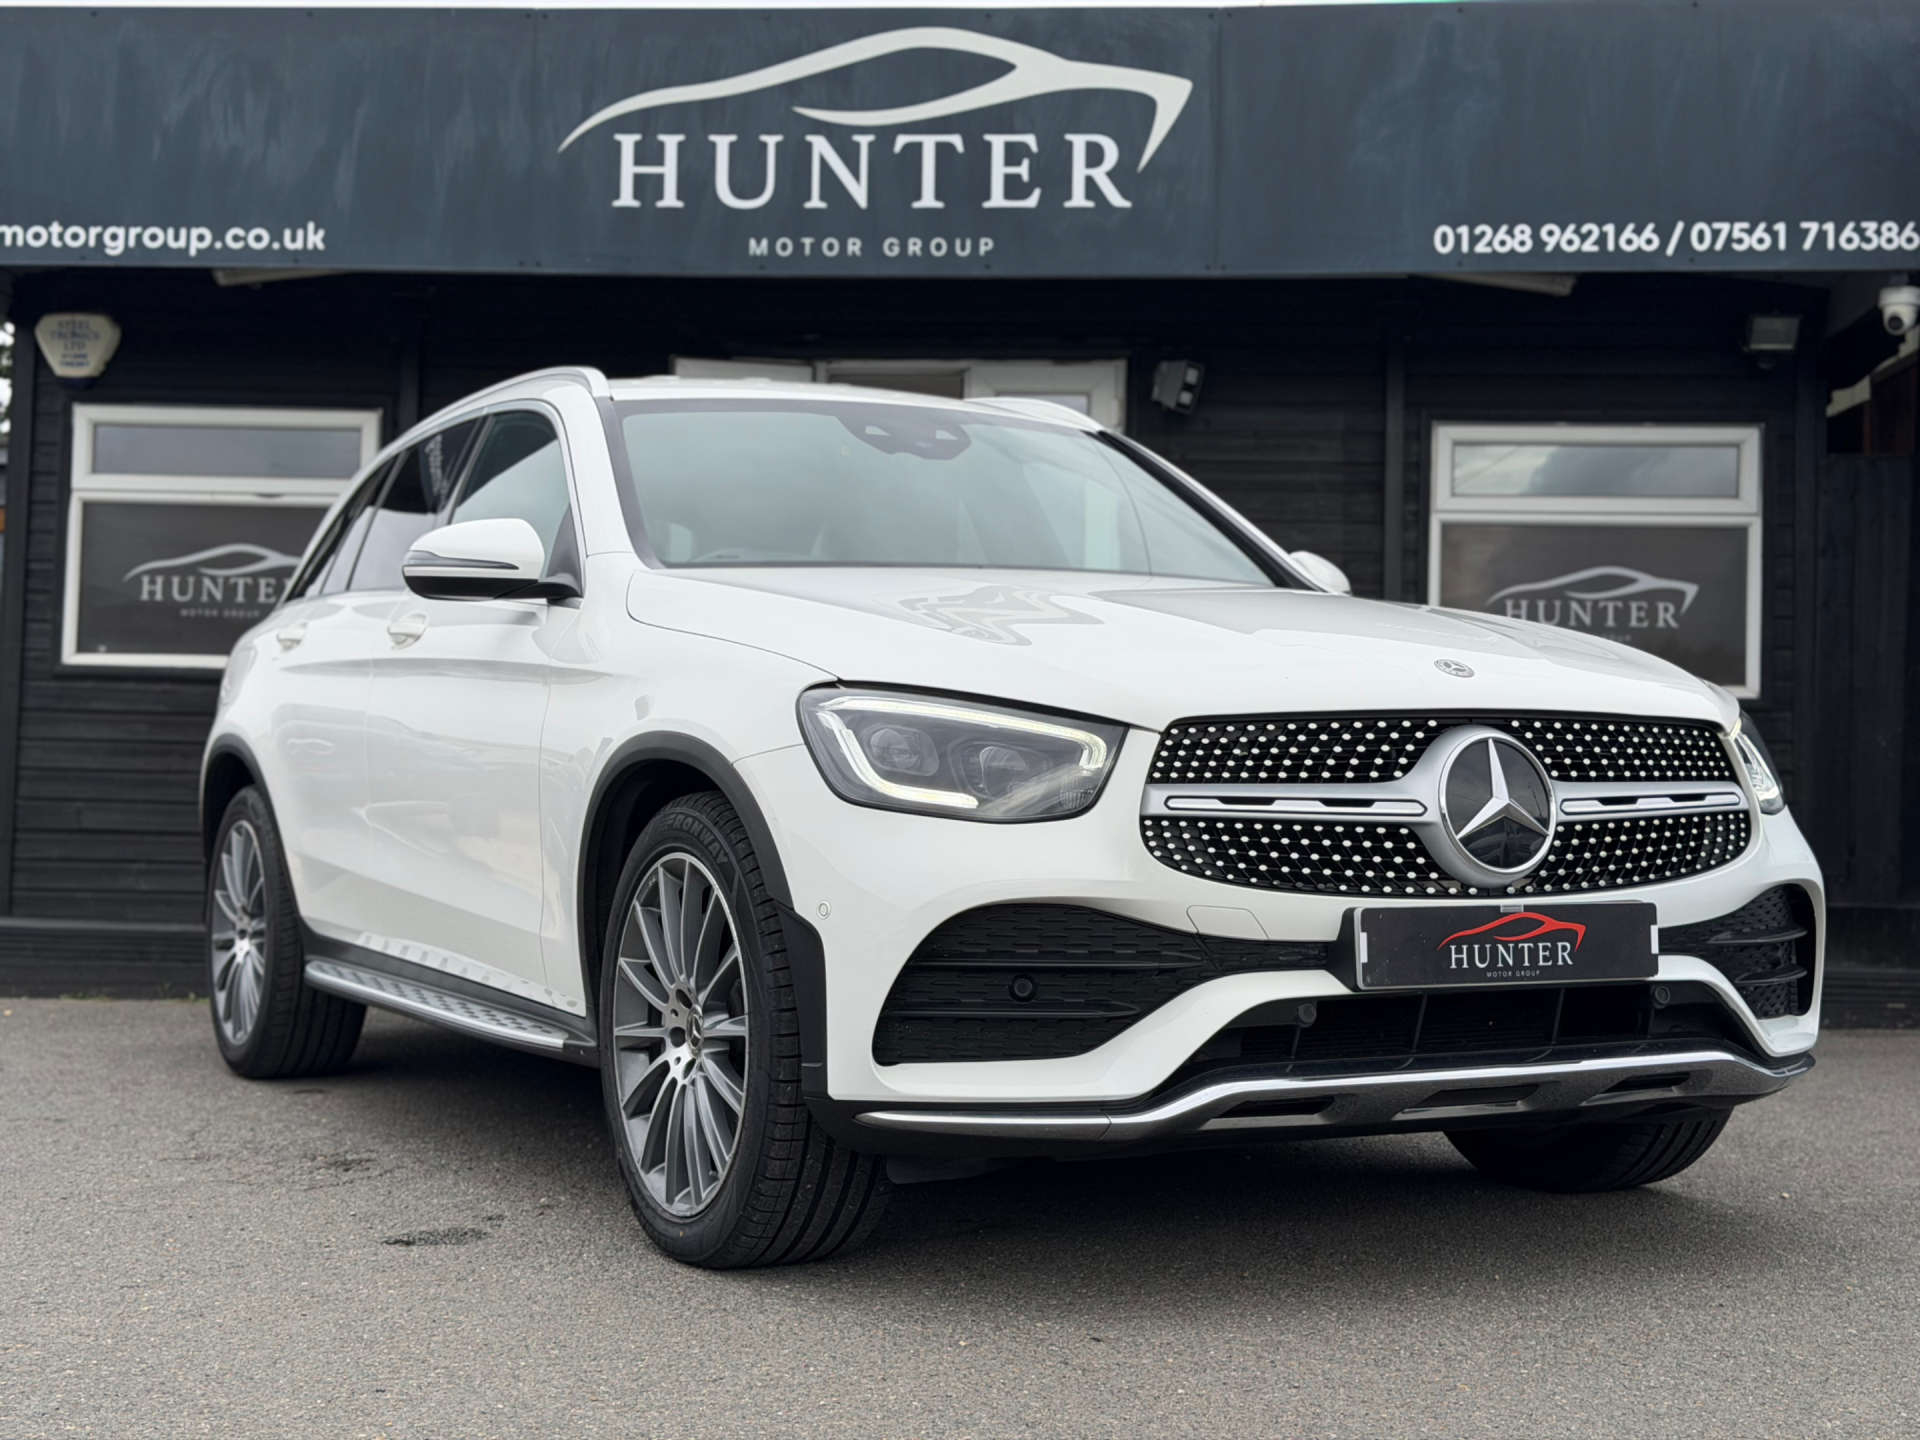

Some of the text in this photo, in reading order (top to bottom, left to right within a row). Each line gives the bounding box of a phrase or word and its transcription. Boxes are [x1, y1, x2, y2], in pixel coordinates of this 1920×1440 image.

[611, 133, 1133, 210] HUNTER
[0, 221, 326, 257] motorgroup.co.uk
[748, 236, 995, 258] MOTOR GROUP
[1433, 223, 1534, 255] 01268
[1539, 222, 1660, 253] 962166
[1690, 221, 1787, 252] 07561
[1800, 220, 1920, 252] 716386
[139, 574, 292, 605] HUNTE
[1503, 598, 1680, 629] HUNTER
[1449, 940, 1574, 970] HUNTER
